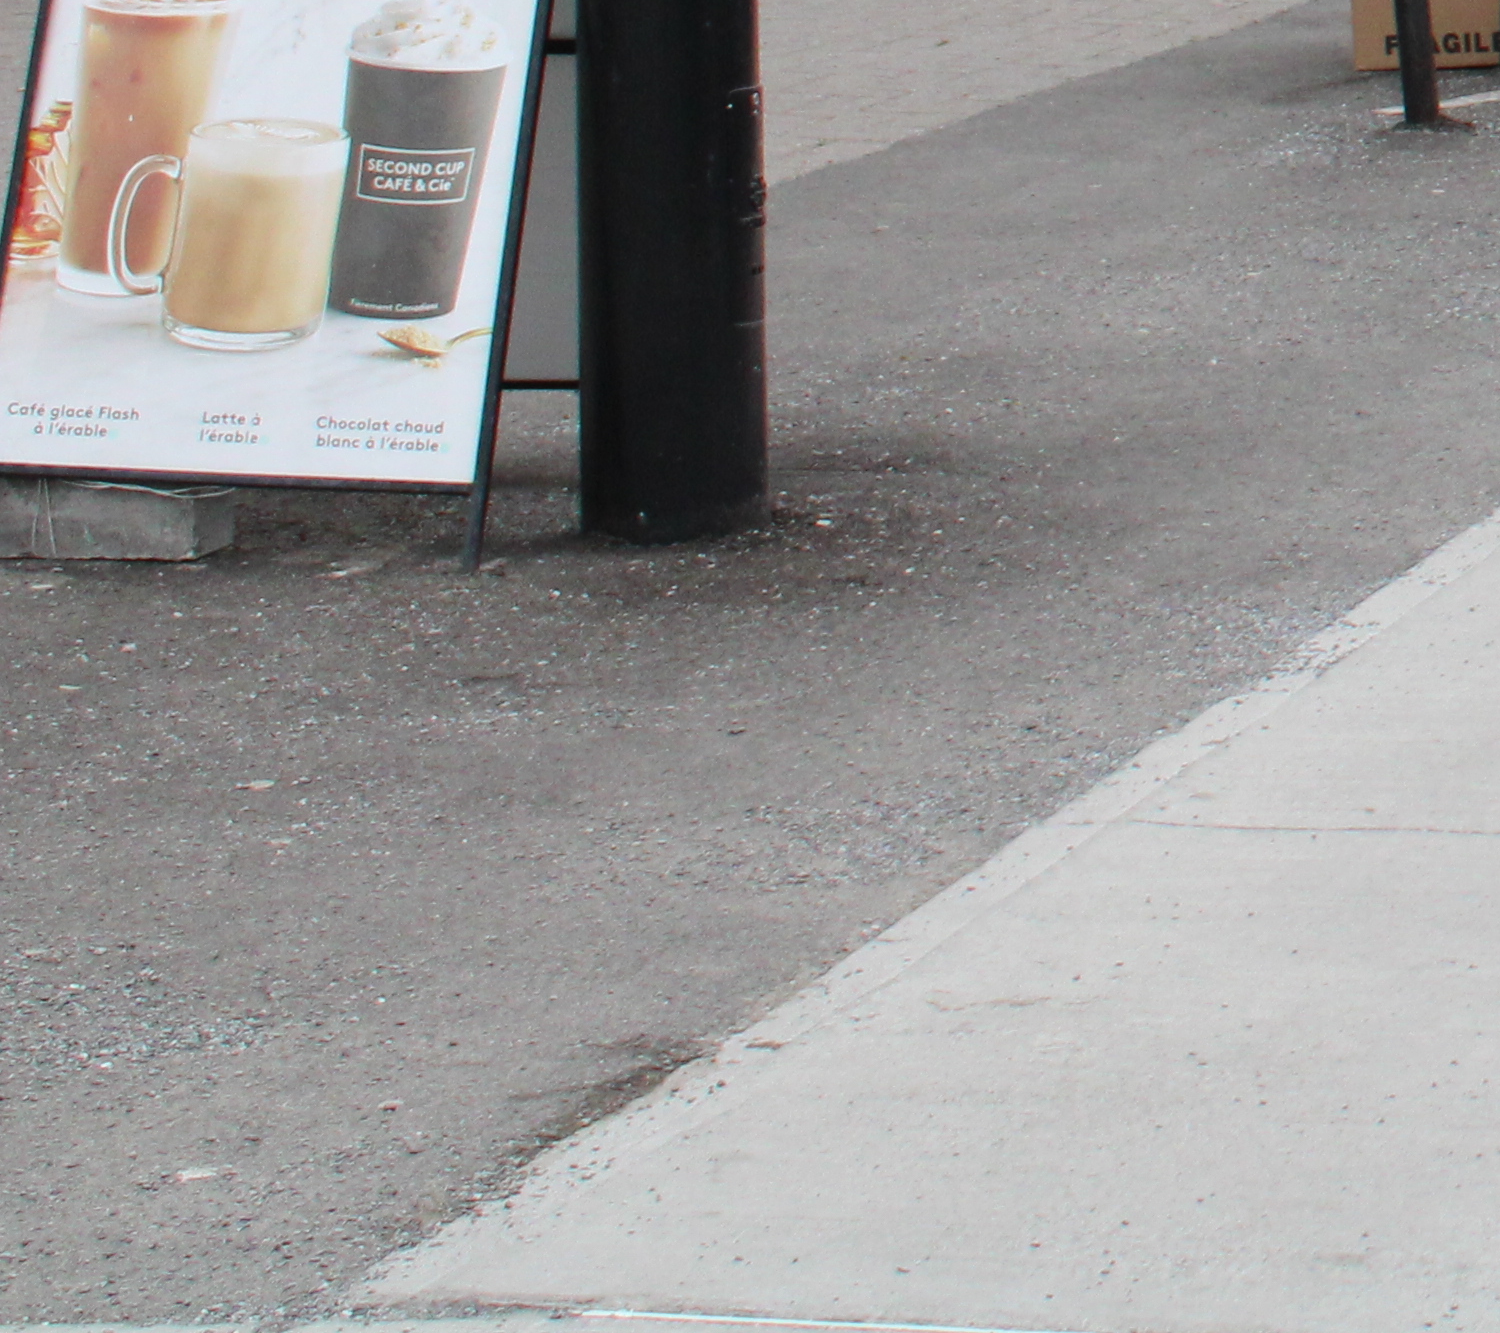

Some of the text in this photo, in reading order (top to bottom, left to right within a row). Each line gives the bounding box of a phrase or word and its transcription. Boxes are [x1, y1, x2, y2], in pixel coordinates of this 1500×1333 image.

[366, 157, 466, 177] SECOND CUP
[372, 173, 453, 193] CAFÉ & Cie
[6, 401, 141, 422] Café glacé Flash
[201, 411, 263, 428] Latte à
[33, 420, 45, 437] à
[315, 414, 446, 435] Chocolat chaud
[315, 434, 361, 451] blanc
[364, 434, 377, 452] à
